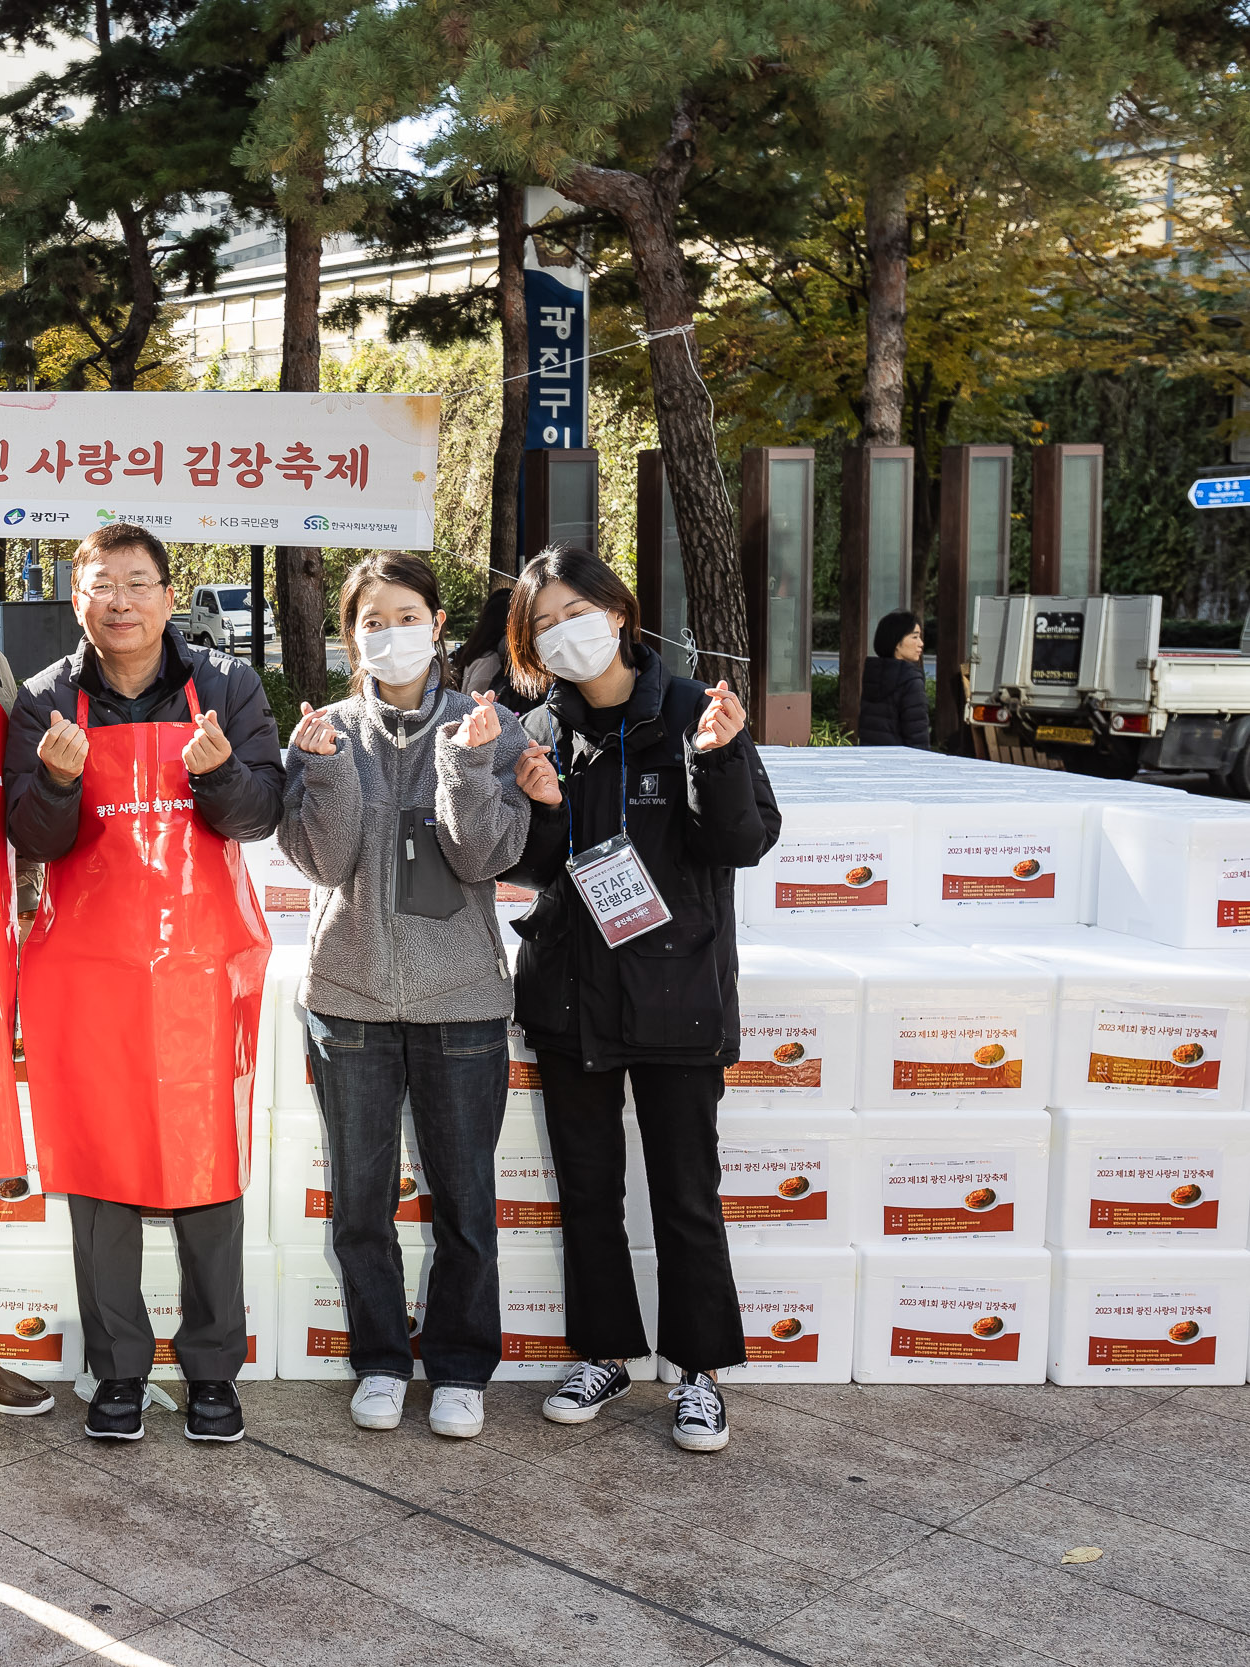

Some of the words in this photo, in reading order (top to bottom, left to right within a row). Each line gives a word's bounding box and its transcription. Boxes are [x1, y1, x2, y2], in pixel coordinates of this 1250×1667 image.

[26, 440, 164, 486] 사랑의
[183, 441, 370, 491] 김장축제
[29, 512, 70, 523] 광진구
[118, 514, 173, 525] 광진복지재단
[332, 521, 398, 533] 한국사회보장정보원
[97, 804, 115, 817] 광진
[118, 802, 149, 814] 사랑의
[152, 799, 194, 813] 김장축제
[832, 854, 852, 862] 사랑의
[854, 853, 882, 861] 김장축제
[591, 867, 634, 898] STAFF
[596, 881, 646, 913] 진행요원
[614, 907, 650, 928] 광진복지재단
[741, 1028, 756, 1037] 광진
[758, 1028, 782, 1037] 사랑의
[785, 1028, 817, 1038] 김장축제
[721, 1164, 741, 1173] 제1회
[744, 1163, 759, 1172] 광진
[762, 1162, 786, 1171] 사랑의
[789, 1160, 820, 1171] 김장축제
[501, 1170, 517, 1178] 2023
[519, 1169, 539, 1178] 제1회
[908, 1176, 928, 1184] 제1회
[930, 1175, 946, 1184] 광진
[949, 1174, 973, 1183] 사랑의
[975, 1173, 1007, 1182] 김장축제
[1116, 1169, 1135, 1178] 제1회
[1138, 1169, 1153, 1178] 광진
[1156, 1169, 1179, 1178] 사랑의
[1182, 1169, 1213, 1178] 김장축제
[0, 1301, 23, 1311] 사랑의
[27, 1302, 58, 1312] 김장축제
[508, 1303, 525, 1312] 2023
[526, 1303, 546, 1312] 제1회
[548, 1303, 564, 1313] 광진
[739, 1303, 754, 1313] 광진
[756, 1303, 780, 1313] 사랑의
[782, 1303, 814, 1313] 김장축제
[919, 1299, 938, 1307] 제1회
[941, 1300, 956, 1309] 광진
[959, 1301, 982, 1310] 사랑의
[985, 1302, 1016, 1311] 김장축제
[1114, 1307, 1133, 1315] 제1회
[1136, 1307, 1151, 1315] 광진
[1154, 1306, 1177, 1315] 사랑의
[1180, 1306, 1211, 1315] 김장축제
